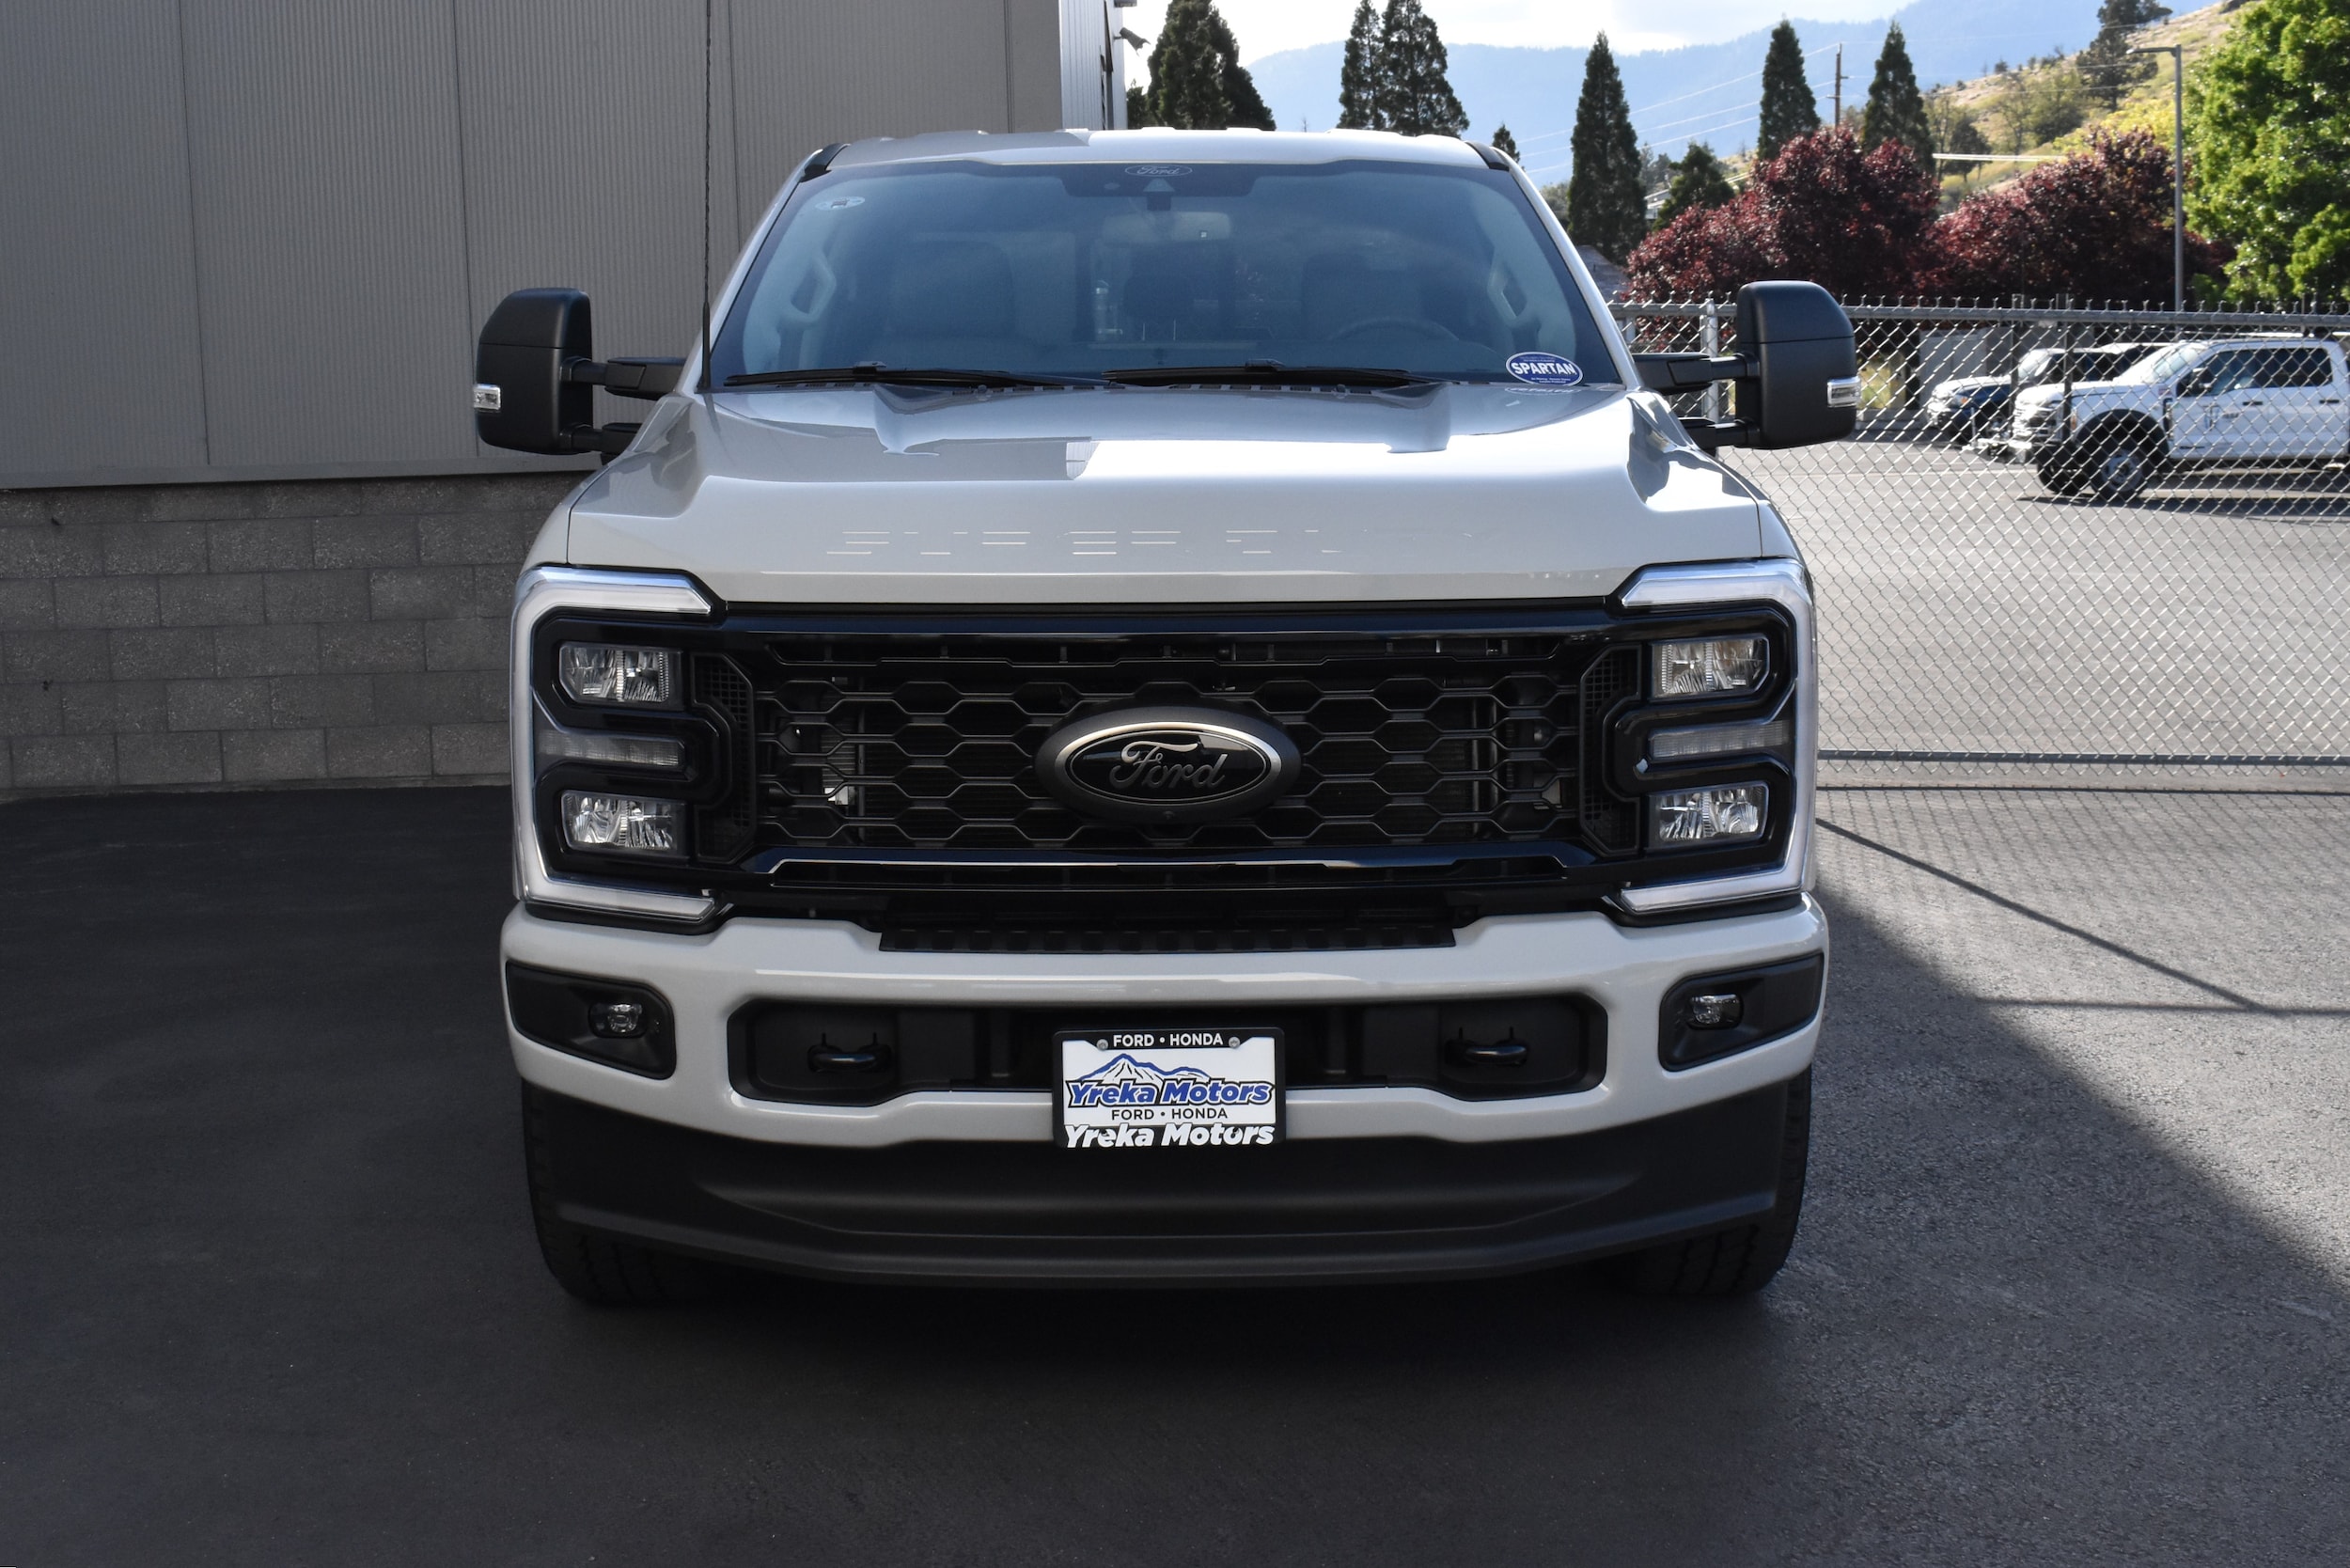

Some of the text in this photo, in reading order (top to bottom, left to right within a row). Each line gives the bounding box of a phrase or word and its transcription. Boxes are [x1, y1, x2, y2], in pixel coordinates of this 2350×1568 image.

[1136, 165, 1181, 175] Ford
[1511, 362, 1577, 375] SPARTAN
[1109, 741, 1228, 789] Ford
[1113, 1033, 1223, 1047] FORD HONDA
[1071, 1080, 1273, 1105] Yreka Motors
[1111, 1107, 1228, 1121] FORD HONDA
[1064, 1122, 1275, 1148] Yreka Motors
